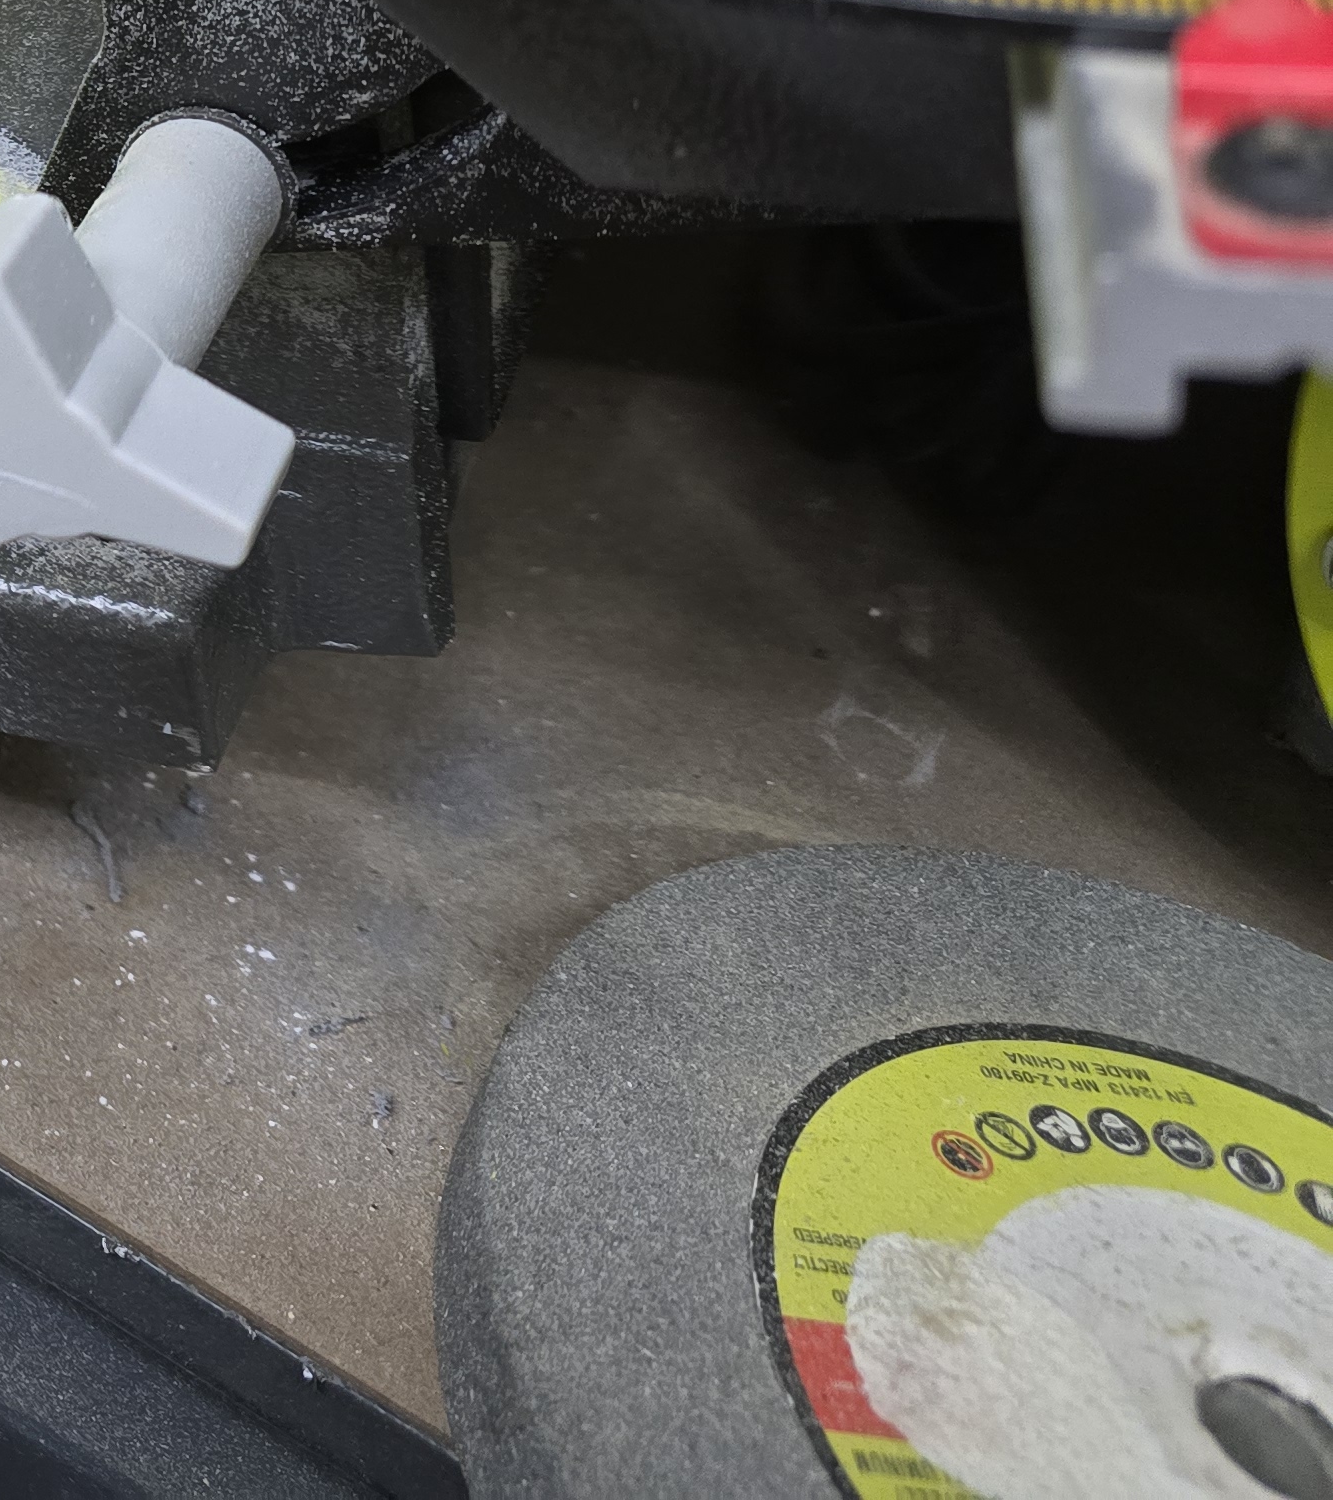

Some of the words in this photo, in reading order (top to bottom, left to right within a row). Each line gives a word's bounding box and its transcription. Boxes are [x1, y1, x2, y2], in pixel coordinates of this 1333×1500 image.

[1003, 1051, 1065, 1070] CHINA
[1068, 1059, 1091, 1074] IN
[1092, 1062, 1151, 1082] MADE
[1054, 1075, 1101, 1093] MPA
[1107, 1081, 1164, 1101] 12413
[1165, 1089, 1197, 1106] EN
[793, 1227, 866, 1249] ERSPEED
